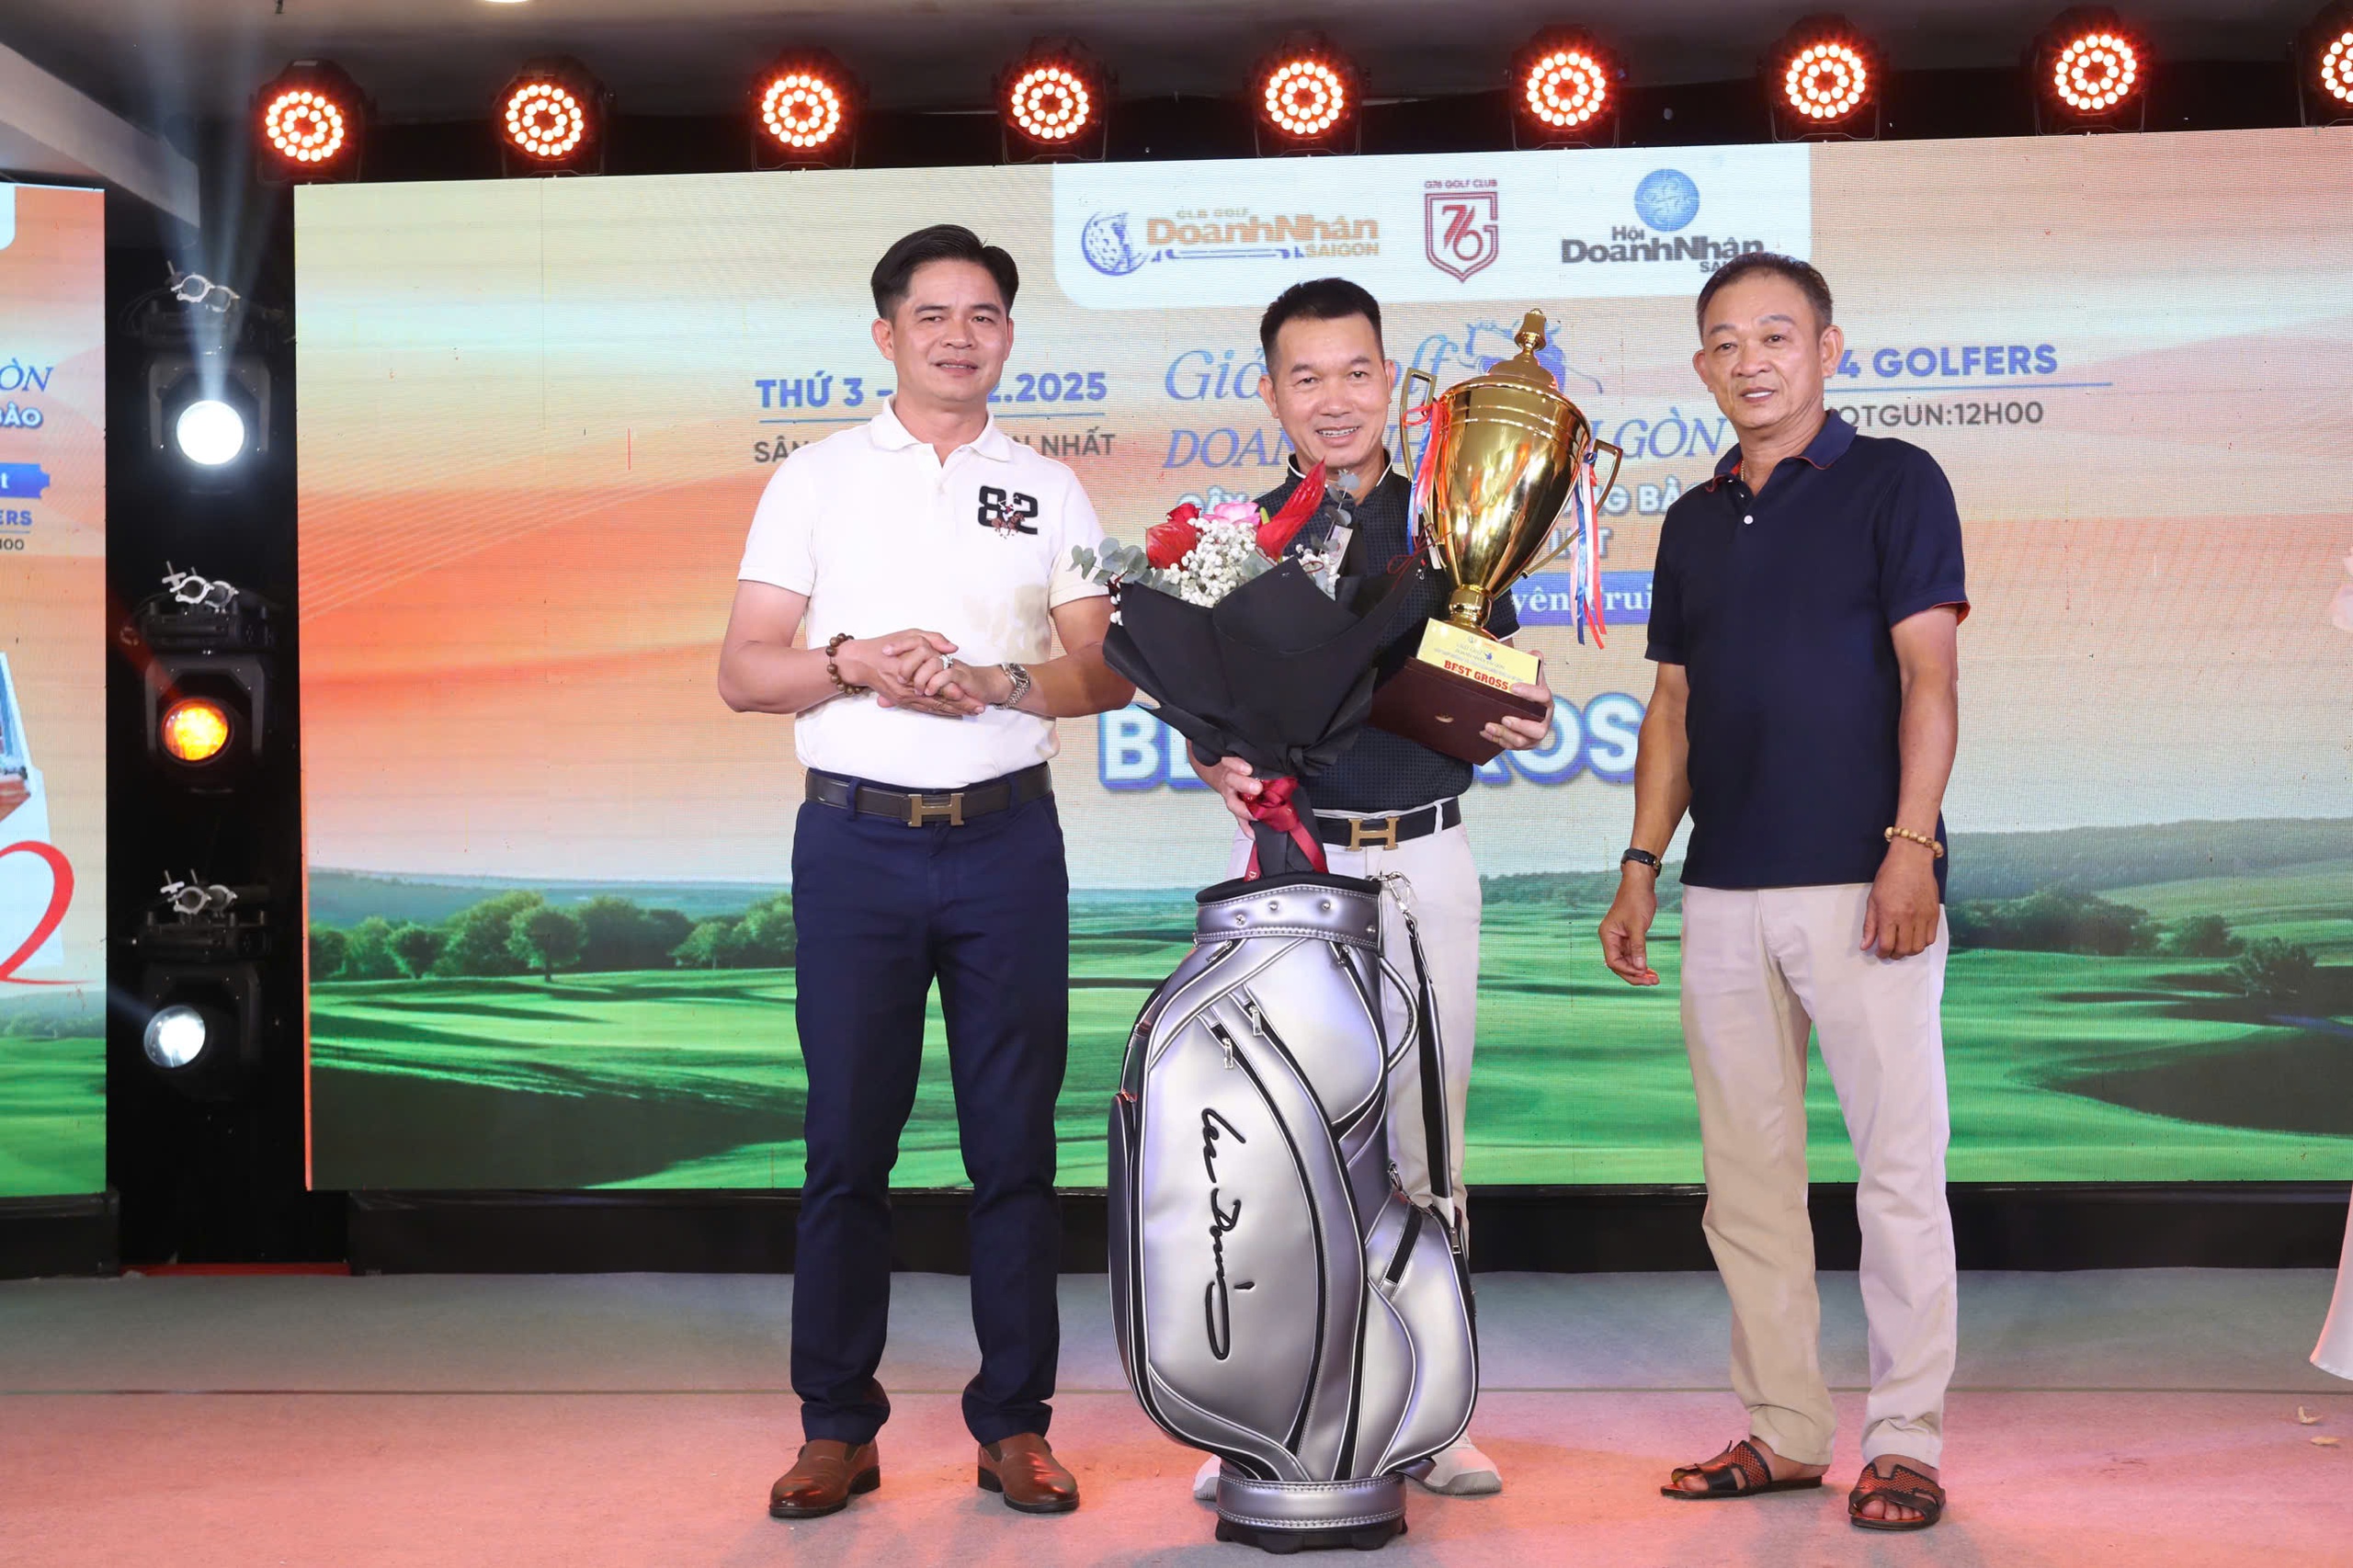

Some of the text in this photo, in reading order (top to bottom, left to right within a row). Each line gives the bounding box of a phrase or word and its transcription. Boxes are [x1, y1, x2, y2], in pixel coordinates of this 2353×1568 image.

[1472, 178, 1497, 187] CLUB
[1147, 214, 1379, 245] DoanhNhân
[1611, 224, 1645, 243] Hội
[1305, 242, 1379, 258] SAIGON
[0, 358, 54, 392] ÒN
[1873, 344, 2057, 378] GOLFERS
[755, 369, 833, 408] THỨ
[843, 376, 864, 407] 3
[1040, 426, 1116, 457] NHẤT
[977, 485, 1039, 535] 82
[1444, 660, 1472, 677] BEST
[1473, 671, 1509, 690] GROSS
